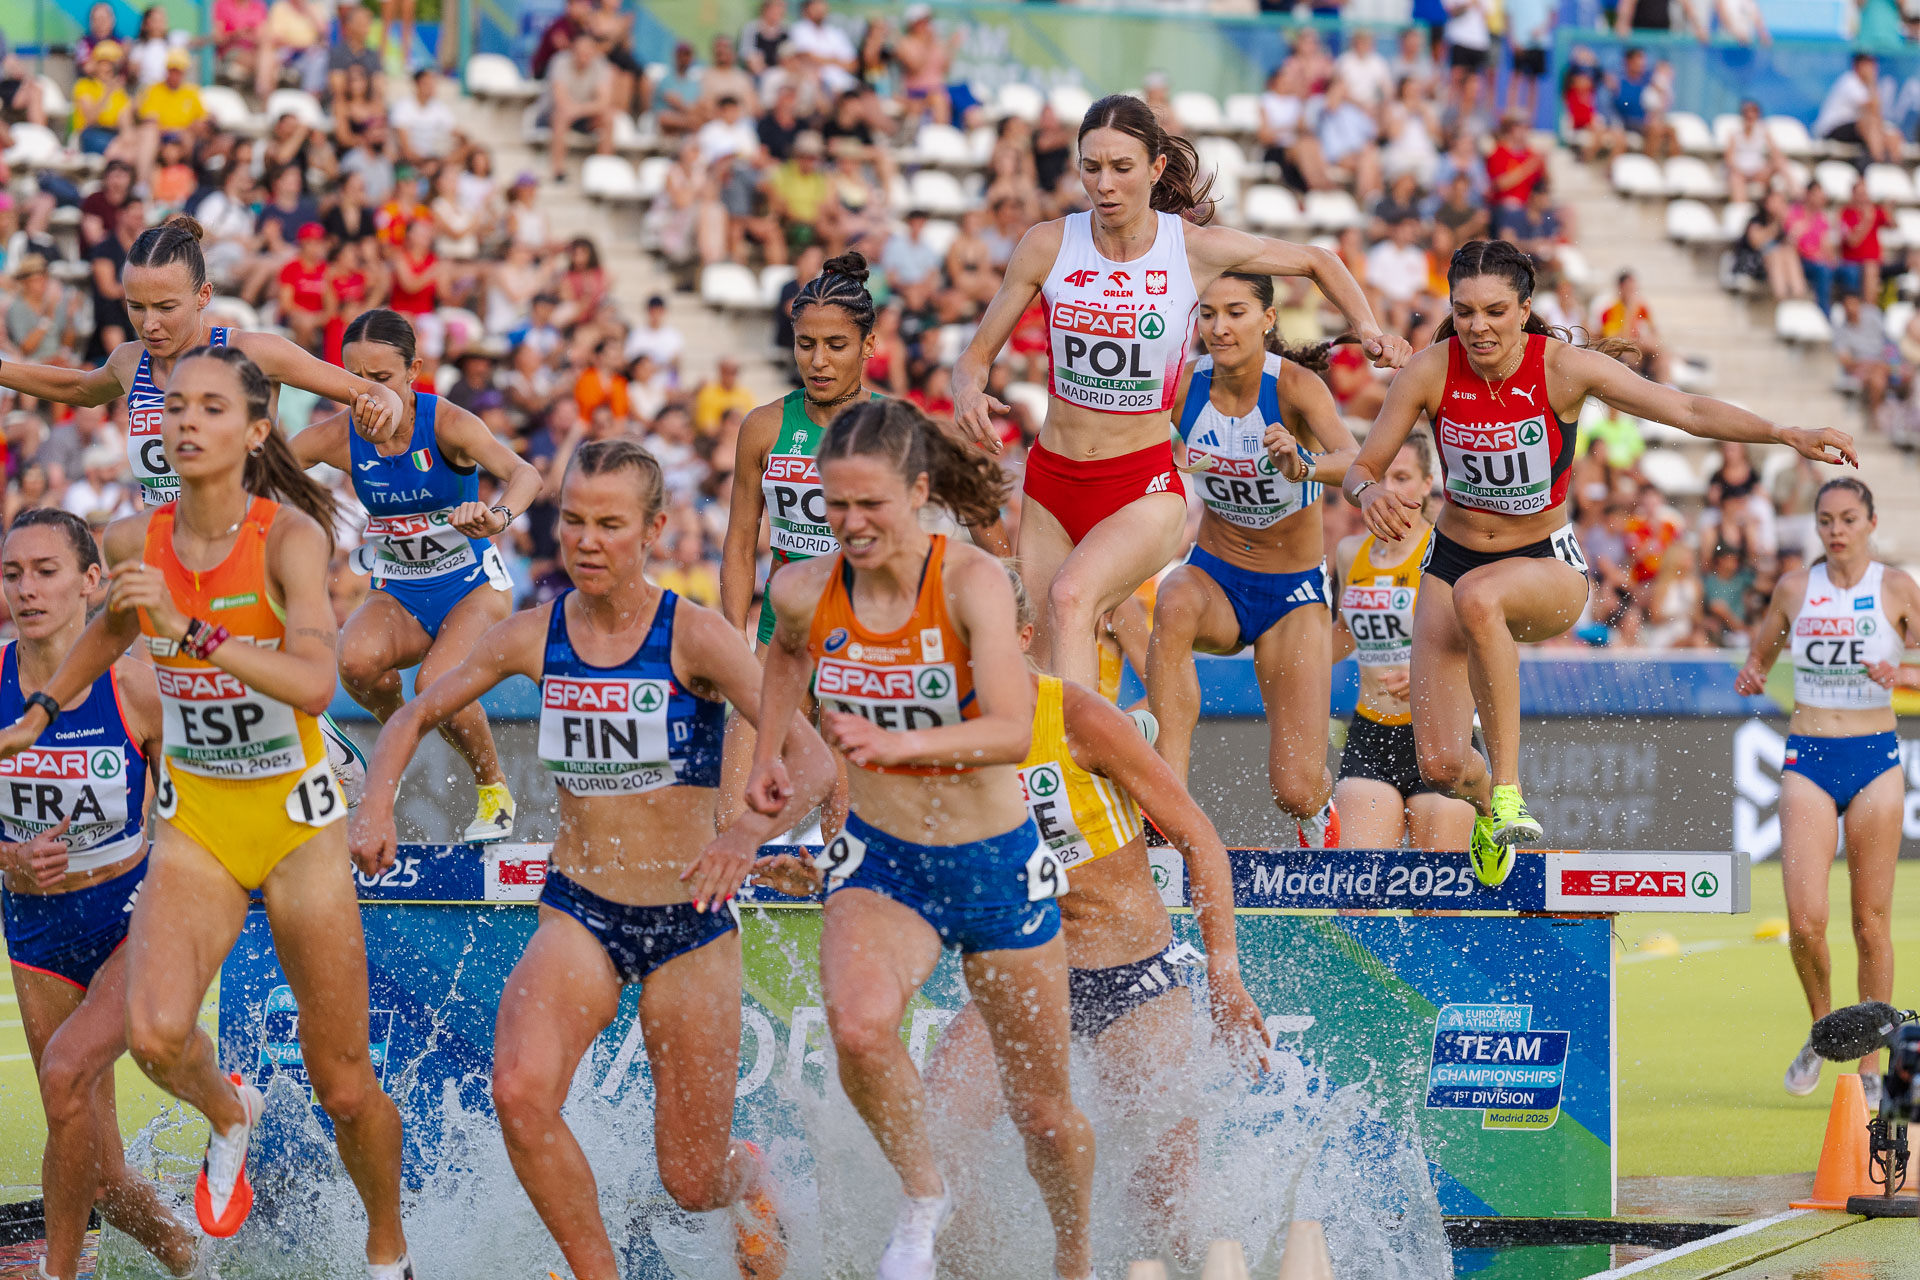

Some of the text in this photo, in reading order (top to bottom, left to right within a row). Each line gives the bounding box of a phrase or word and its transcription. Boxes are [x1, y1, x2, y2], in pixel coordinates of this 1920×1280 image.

[1064, 270, 1099, 287] 4F
[1055, 307, 1133, 334] SPAR
[1065, 335, 1151, 377] POL
[1076, 375, 1097, 387] RUN
[1062, 383, 1153, 406] MADRID 2025
[1461, 392, 1476, 400] UBS
[133, 413, 162, 432] SP
[1444, 425, 1516, 449] SPAR
[768, 460, 819, 479] SPA
[1462, 452, 1530, 486] SUI
[159, 478, 180, 486] RUN
[1145, 472, 1170, 494] 4F
[1205, 476, 1279, 505] GRE
[1471, 486, 1490, 496] RUN
[372, 488, 433, 503] ITALIA
[775, 486, 828, 523] PO
[1514, 495, 1545, 511] 2025
[1220, 503, 1238, 512] RUN
[1219, 512, 1256, 525] ADRID
[792, 524, 815, 533] RUN
[816, 527, 834, 535] CLE
[778, 532, 830, 552] MADRID
[384, 564, 432, 575] MADRID
[1343, 591, 1390, 608] SPAR
[1352, 614, 1408, 640] GER
[1797, 618, 1853, 635] SPAR
[1806, 640, 1864, 665] CZE
[159, 670, 243, 698] SPAR
[821, 665, 912, 697] SPAR
[547, 683, 627, 708] SPAR
[56, 727, 104, 740] Crédit Mutuel
[179, 703, 264, 746] ESP
[563, 716, 639, 759] FIN
[192, 749, 216, 761] RUN
[250, 753, 292, 773] 2025
[569, 763, 594, 773] RUN
[555, 769, 663, 791] MADRID 2025
[10, 782, 106, 822] FRA
[293, 774, 335, 821] 13
[826, 837, 849, 875] 9
[1040, 857, 1058, 895] 9
[1253, 864, 1475, 896] Madrid 2025
[1590, 874, 1684, 892] SPAR
[621, 924, 675, 935] CRAFT
[1465, 1019, 1521, 1028] ATHLETICS
[1466, 1010, 1521, 1019] EUROPEAN
[1457, 1035, 1541, 1060] TEAM
[1438, 1069, 1556, 1083] CHAMPIONSHIPS
[1453, 1091, 1534, 1104] 1ST DIVISION
[1490, 1113, 1549, 1123] Madrid 2025
